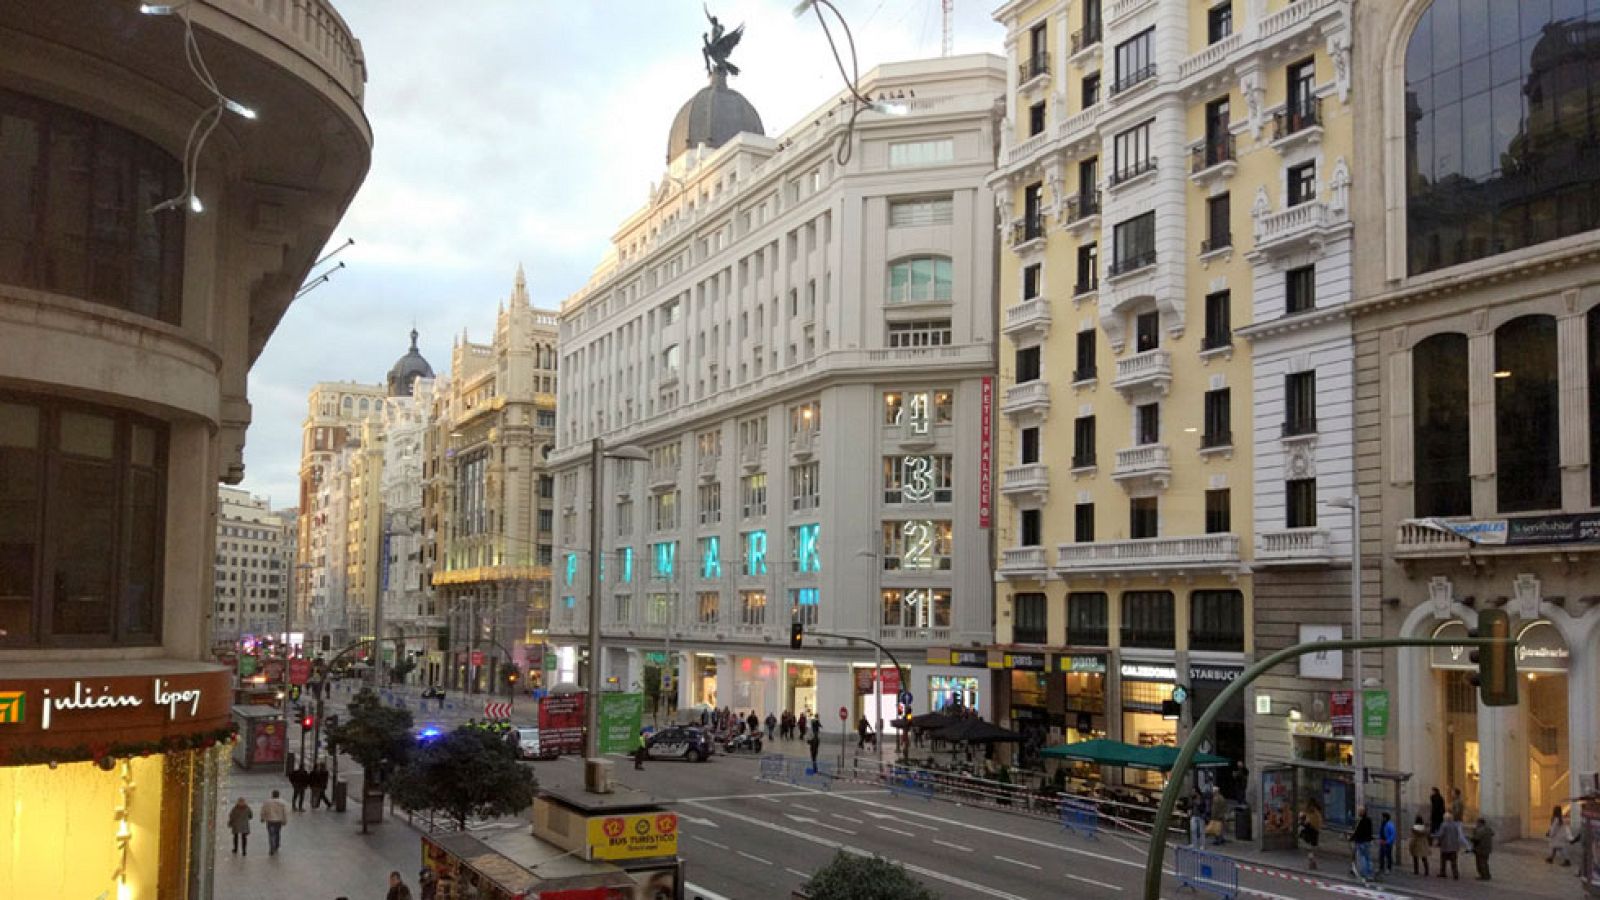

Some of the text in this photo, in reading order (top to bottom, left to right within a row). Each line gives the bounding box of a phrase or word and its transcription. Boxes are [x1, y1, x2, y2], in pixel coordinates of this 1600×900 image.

[981, 383, 991, 504] PETIT PALACE
[904, 455, 934, 500] 3
[904, 520, 933, 568] 2
[905, 589, 932, 633] 1
[1072, 656, 1098, 669] pans
[1189, 667, 1243, 680] STARBUCK
[41, 678, 200, 730] julián lópez
[609, 837, 628, 847] BUS
